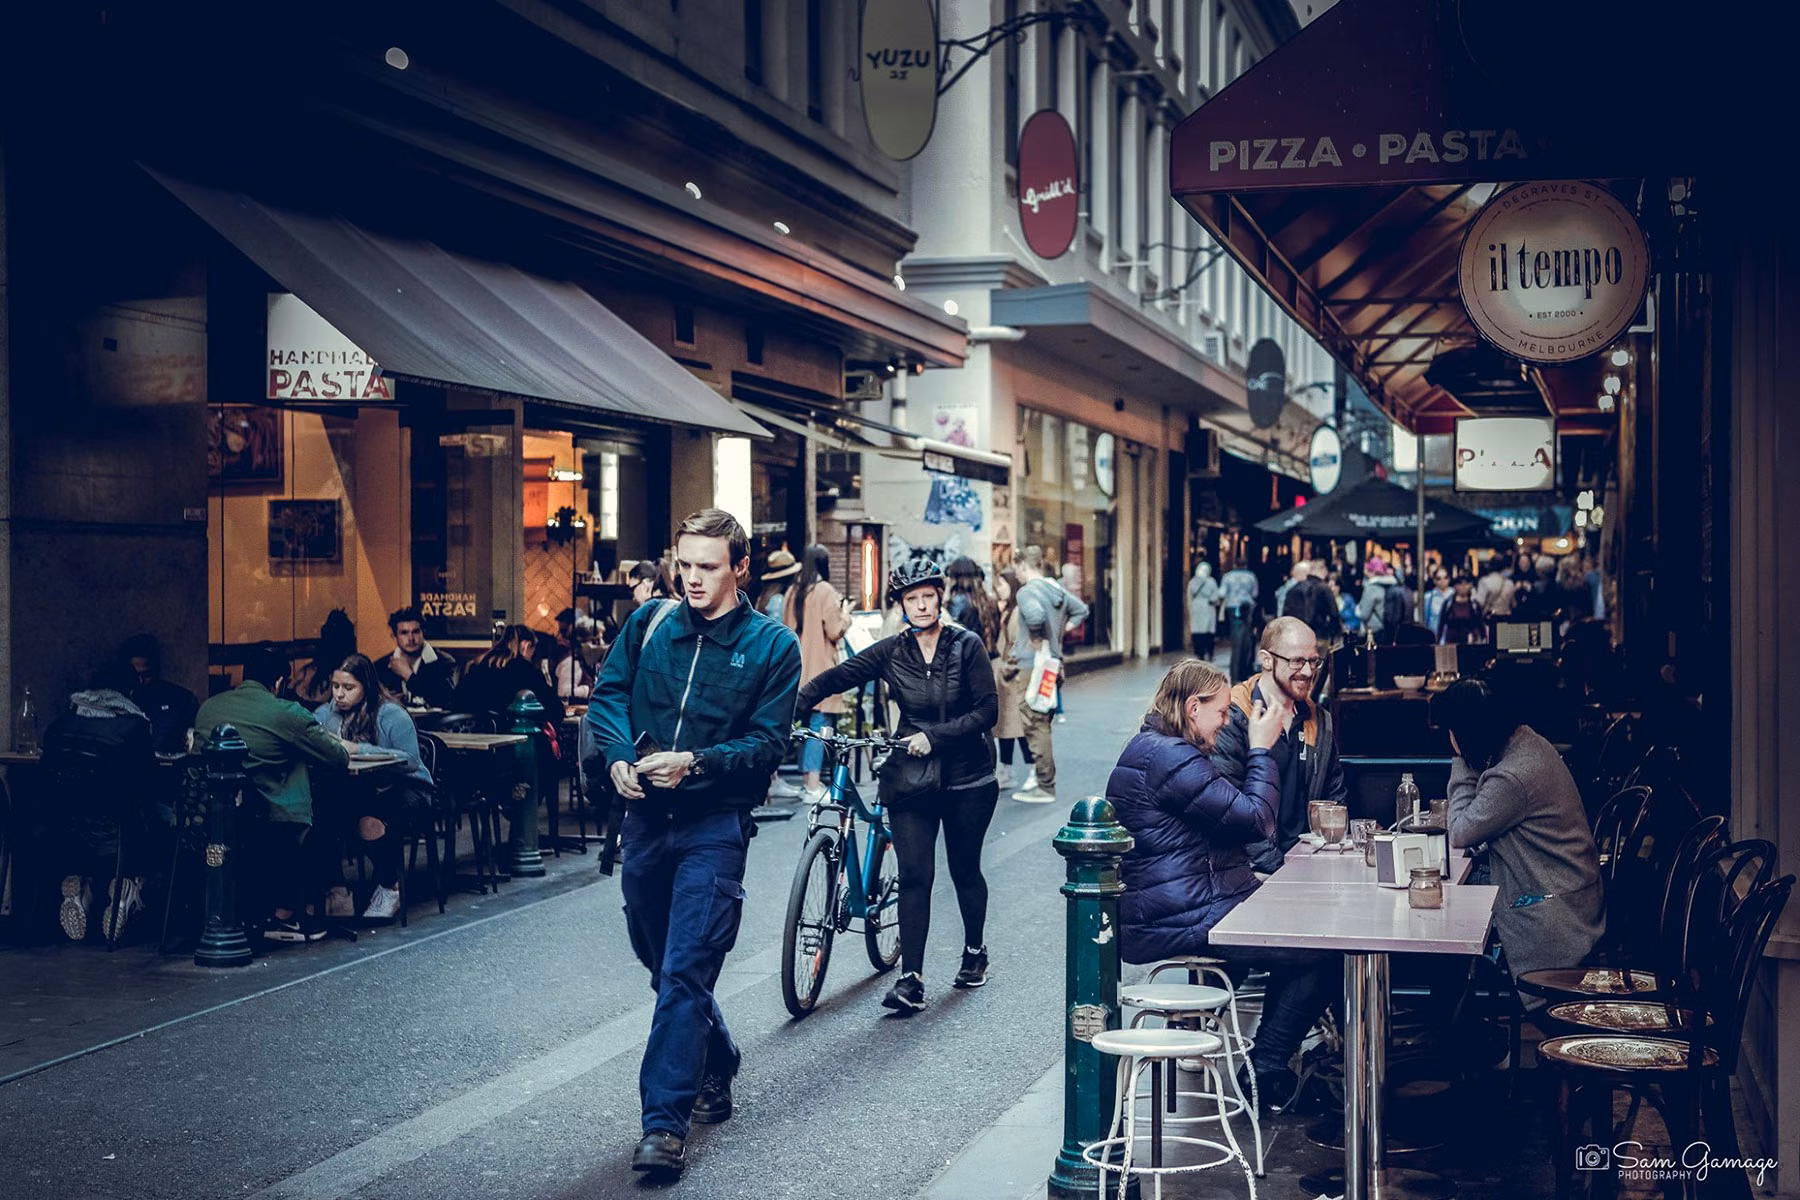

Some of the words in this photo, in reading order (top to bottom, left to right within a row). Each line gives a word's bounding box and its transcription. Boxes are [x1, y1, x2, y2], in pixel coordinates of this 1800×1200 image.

[866, 48, 930, 69] YUZU
[1209, 136, 1343, 172] PIZZA
[1379, 129, 1528, 165] PASTA
[1503, 184, 1578, 209] DEGRAVES
[1584, 189, 1601, 204] ST
[1488, 243, 1509, 292] il
[1516, 238, 1623, 300] tempo
[1536, 311, 1553, 319] EST
[1518, 331, 1604, 354] MELBOURNE
[269, 368, 391, 399] PASTA
